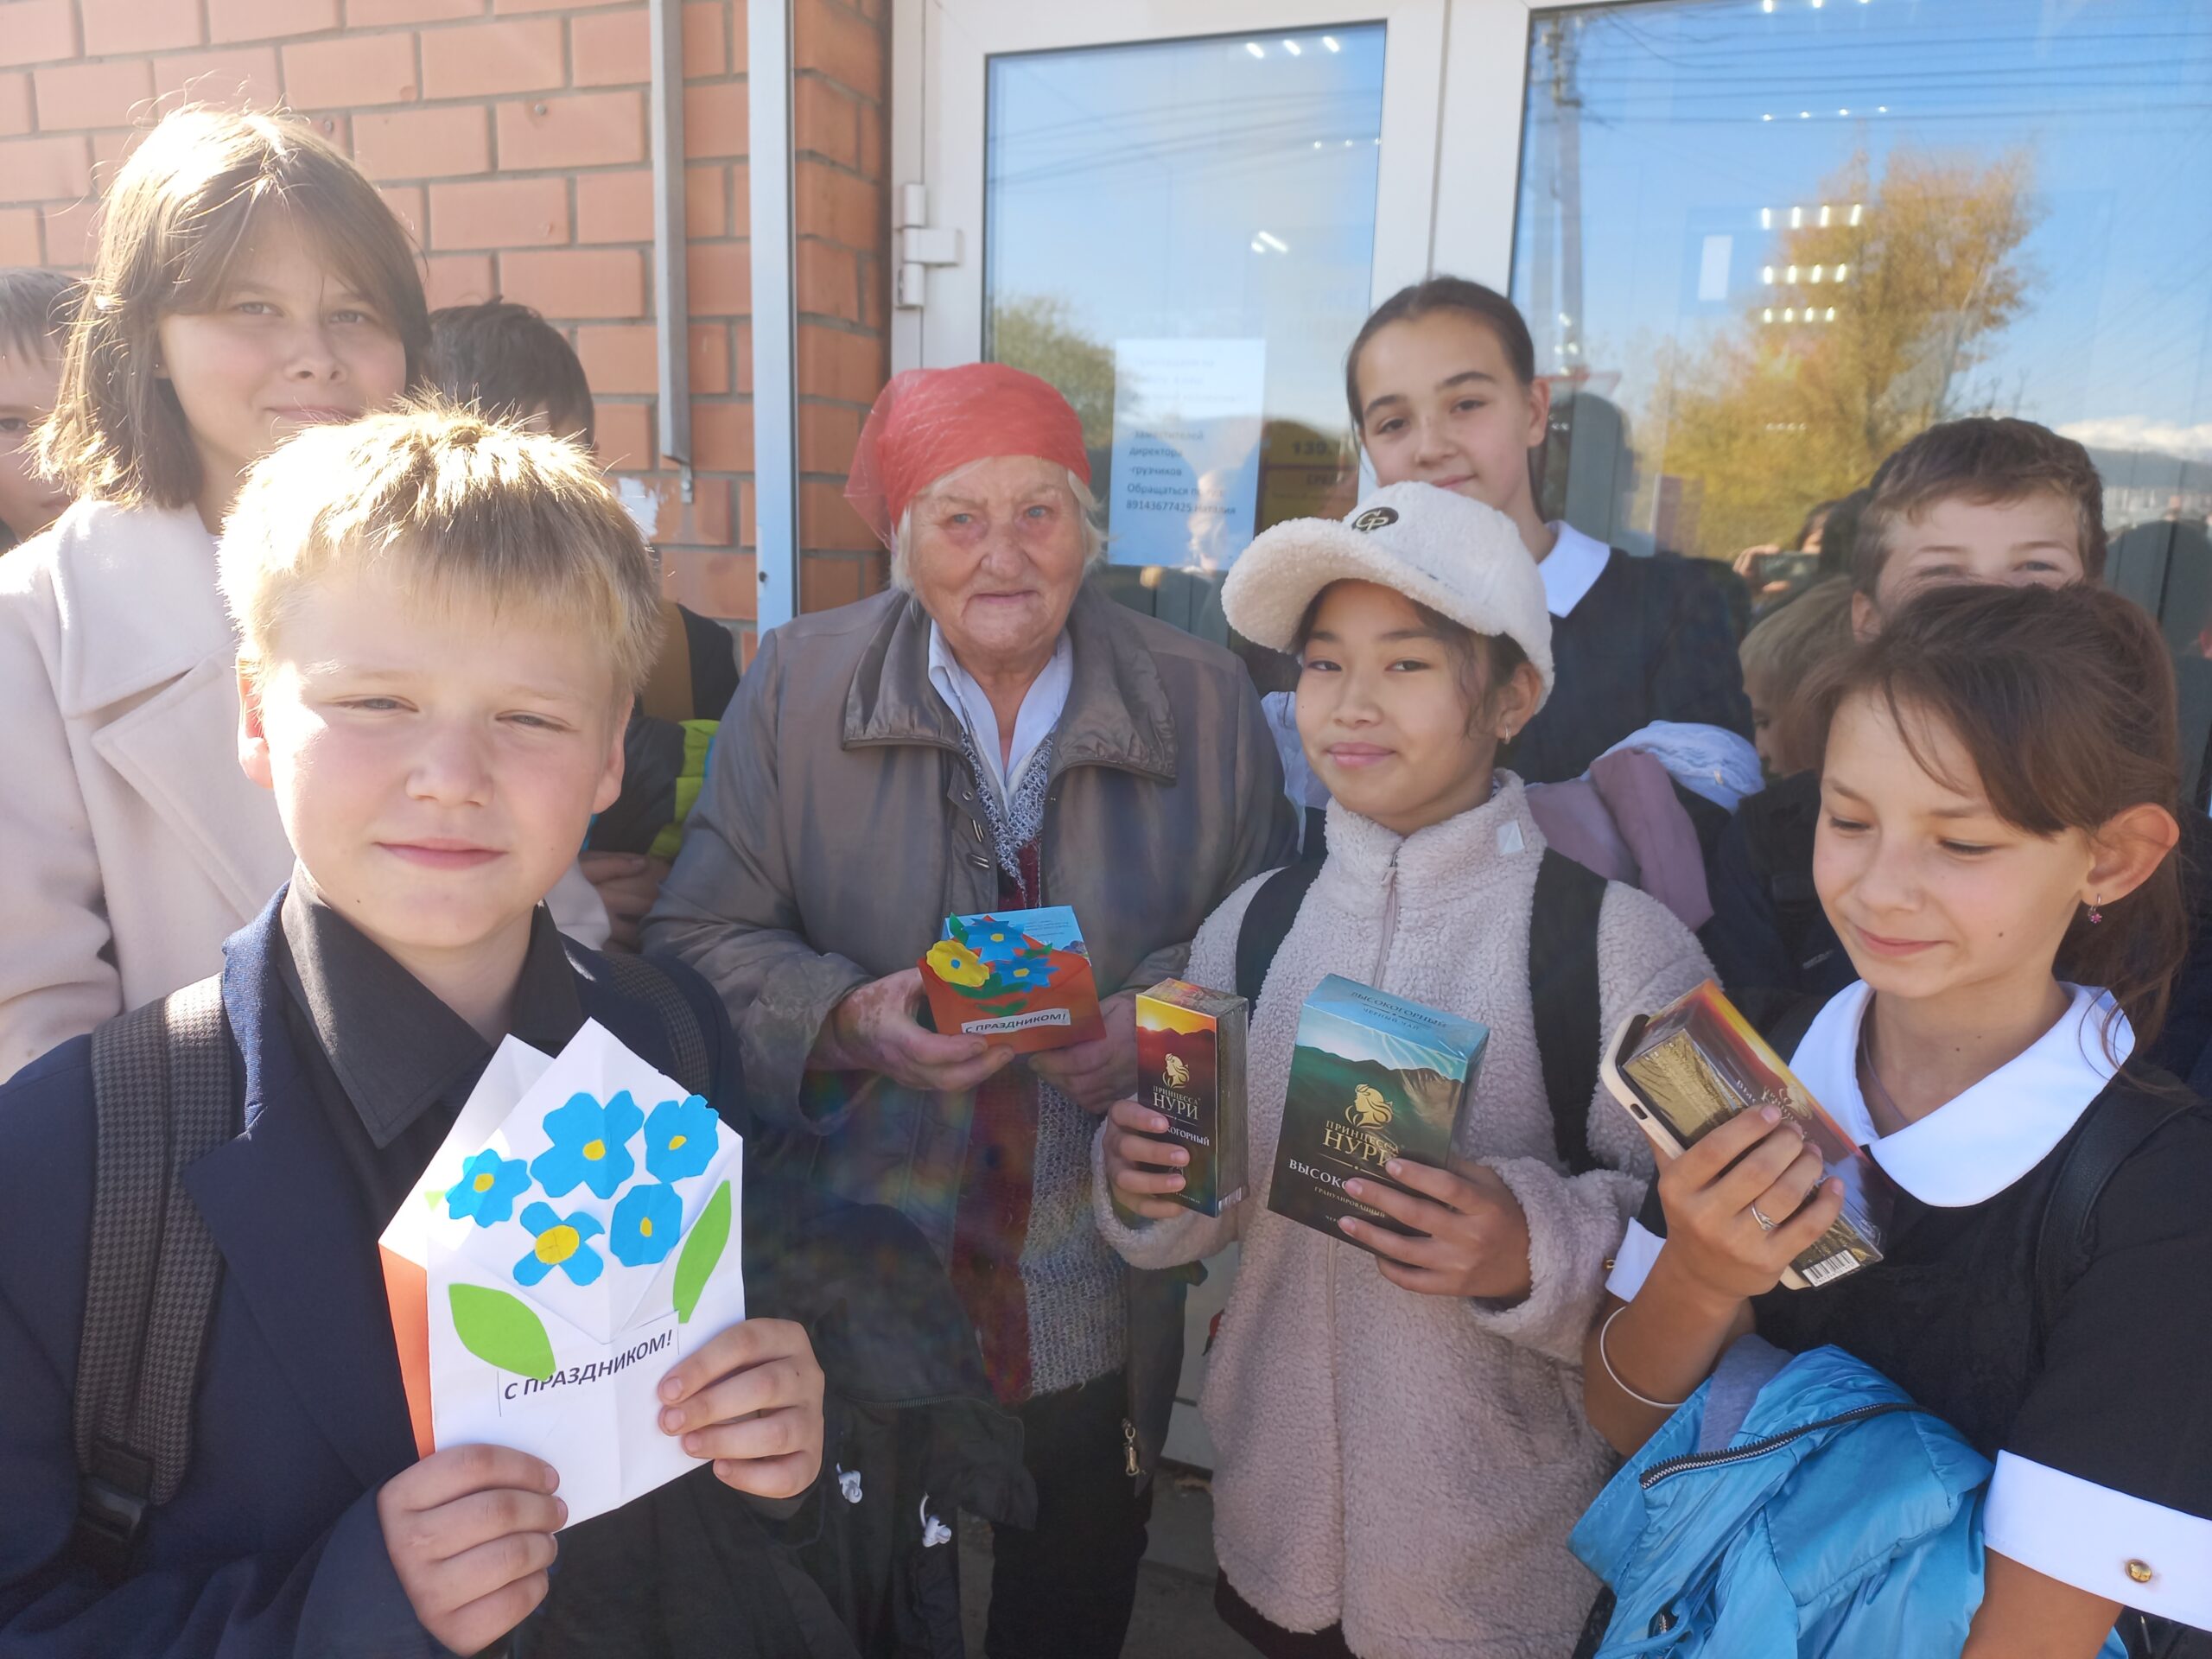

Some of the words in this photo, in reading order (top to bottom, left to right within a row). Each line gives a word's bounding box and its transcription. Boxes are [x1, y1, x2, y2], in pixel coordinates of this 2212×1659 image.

[1127, 483, 1189, 496] Обращаться
[976, 1013, 1066, 1032] ПРАЗДНИКОМ!
[1153, 1084, 1198, 1106] ПРИНЦЕССА
[1153, 1092, 1198, 1121] НУРИ
[1325, 1120, 1400, 1154] ПРИНЦЕССА
[504, 1382, 518, 1400] С
[523, 1329, 673, 1395] ПРАЗДНИКОМ!
